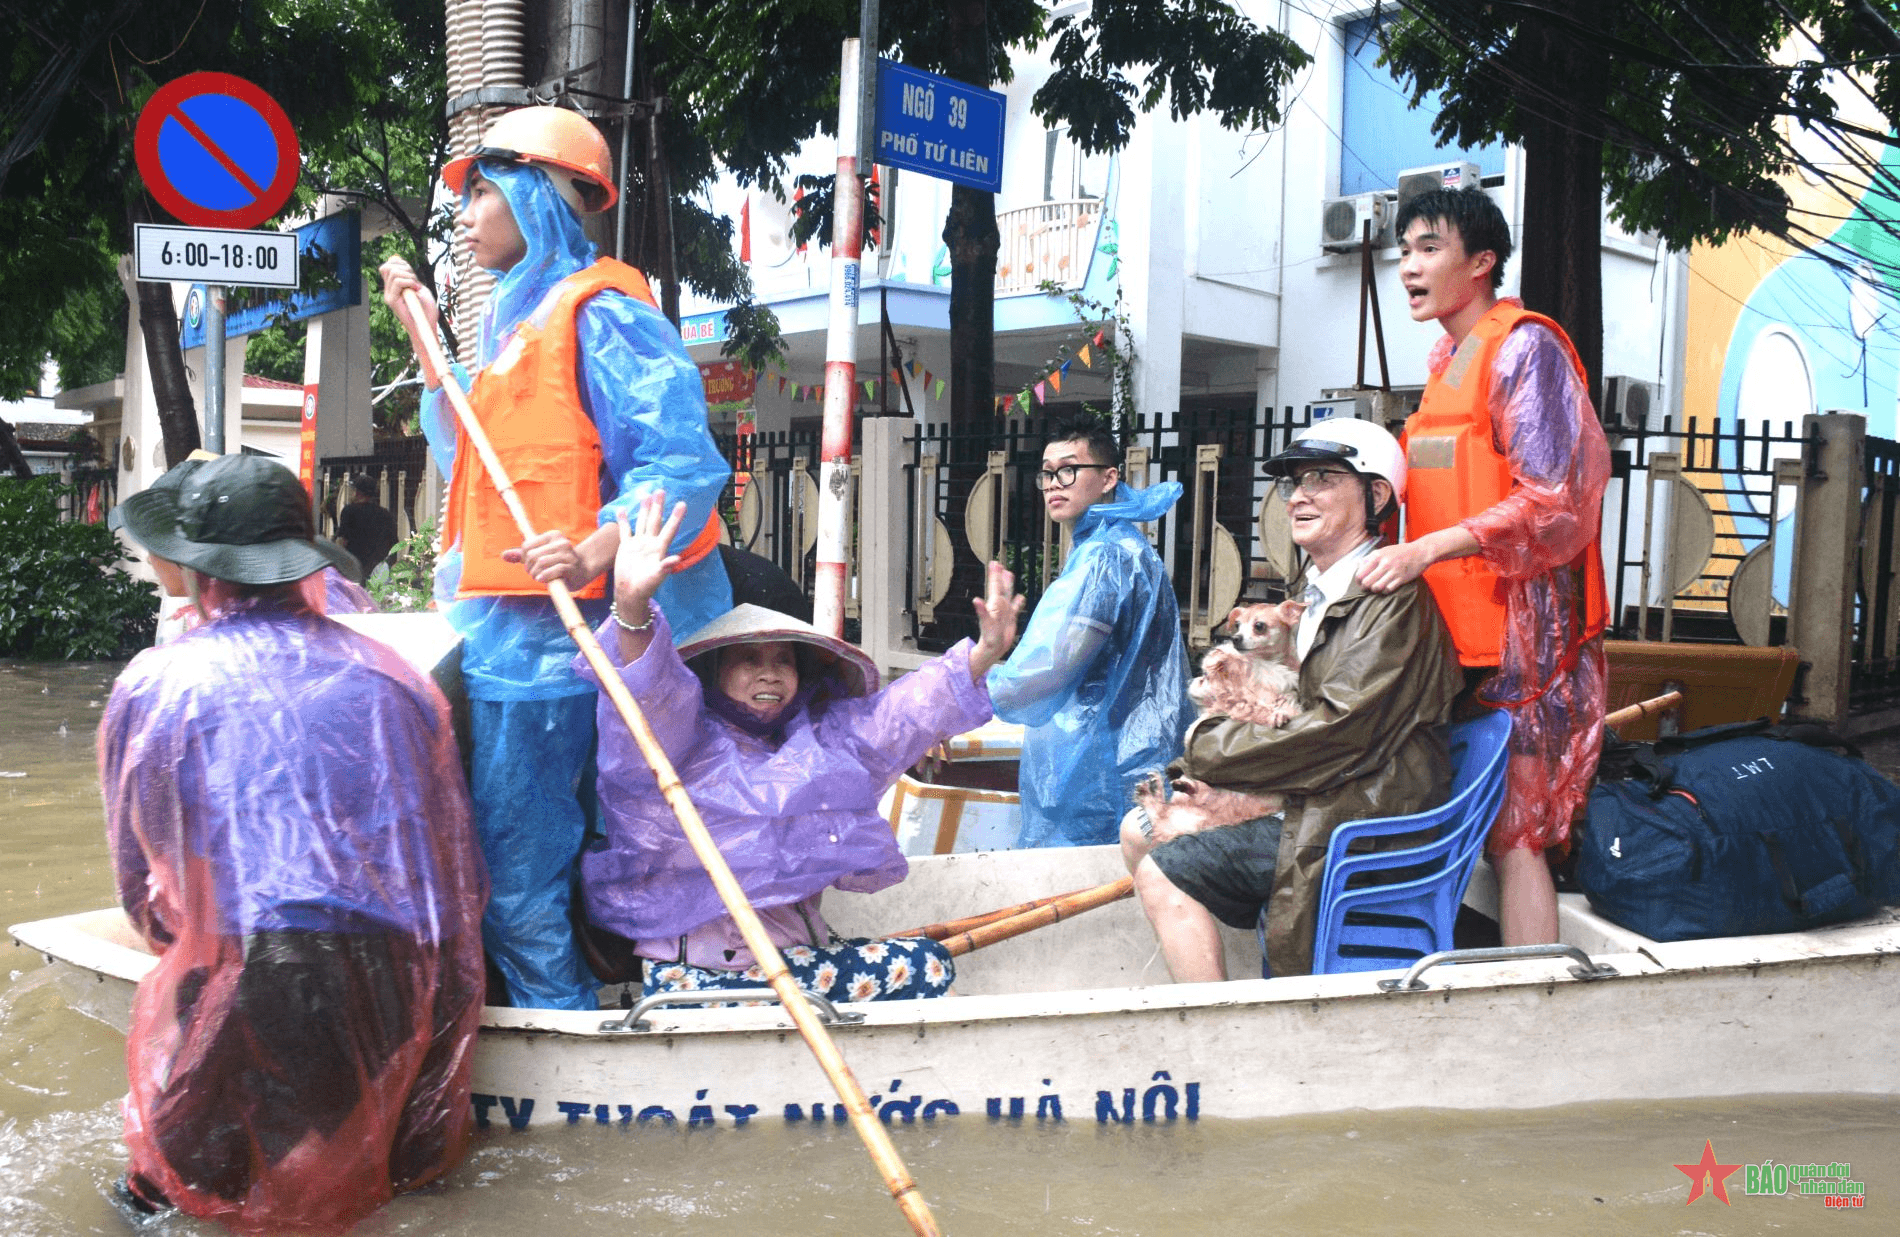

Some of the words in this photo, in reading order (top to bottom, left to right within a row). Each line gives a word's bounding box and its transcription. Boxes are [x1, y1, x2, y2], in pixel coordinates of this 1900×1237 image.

[902, 82, 935, 122] NGÕ
[948, 95, 968, 130] 39
[880, 130, 919, 156] PHỐ
[923, 139, 948, 162] TỨ
[950, 148, 990, 175] LIÊN
[161, 241, 279, 270] 6:00-18:00
